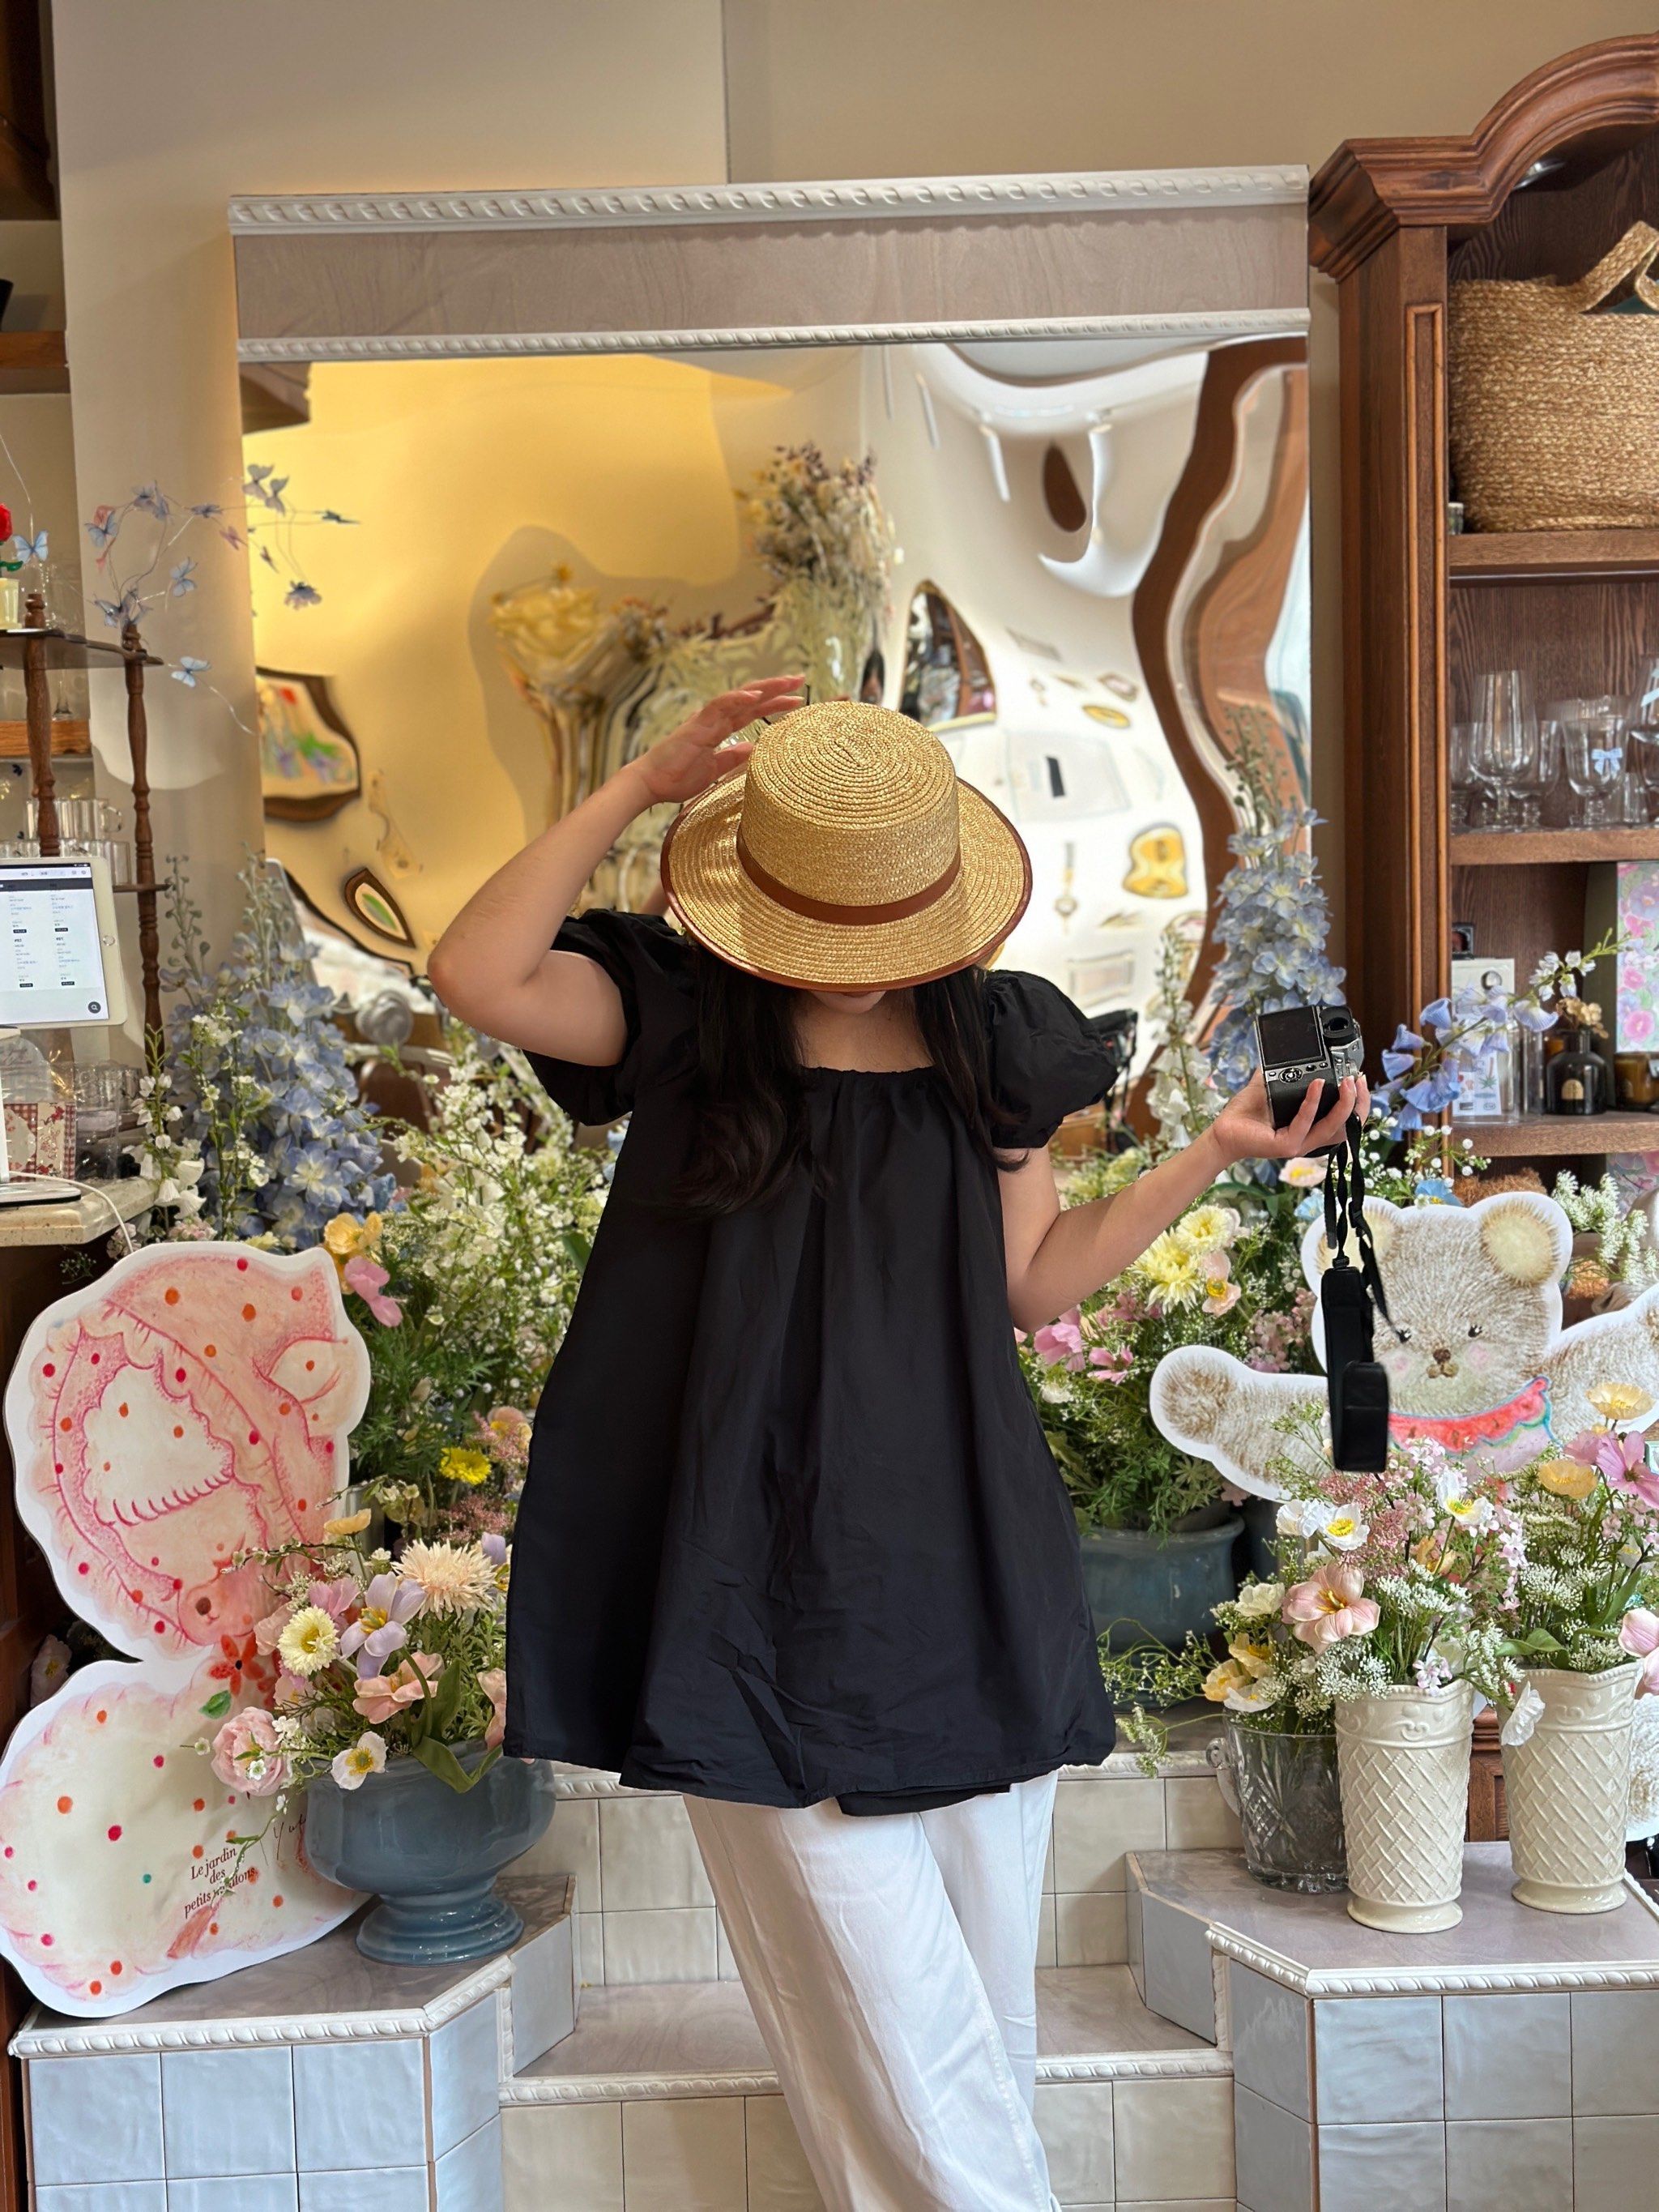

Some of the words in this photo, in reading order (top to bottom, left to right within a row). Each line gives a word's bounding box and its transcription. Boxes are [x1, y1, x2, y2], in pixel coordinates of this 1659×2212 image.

[190, 1865, 203, 1880] Le
[205, 1847, 237, 1877] jardin
[209, 1868, 226, 1885] des
[184, 1892, 211, 1919] petits
